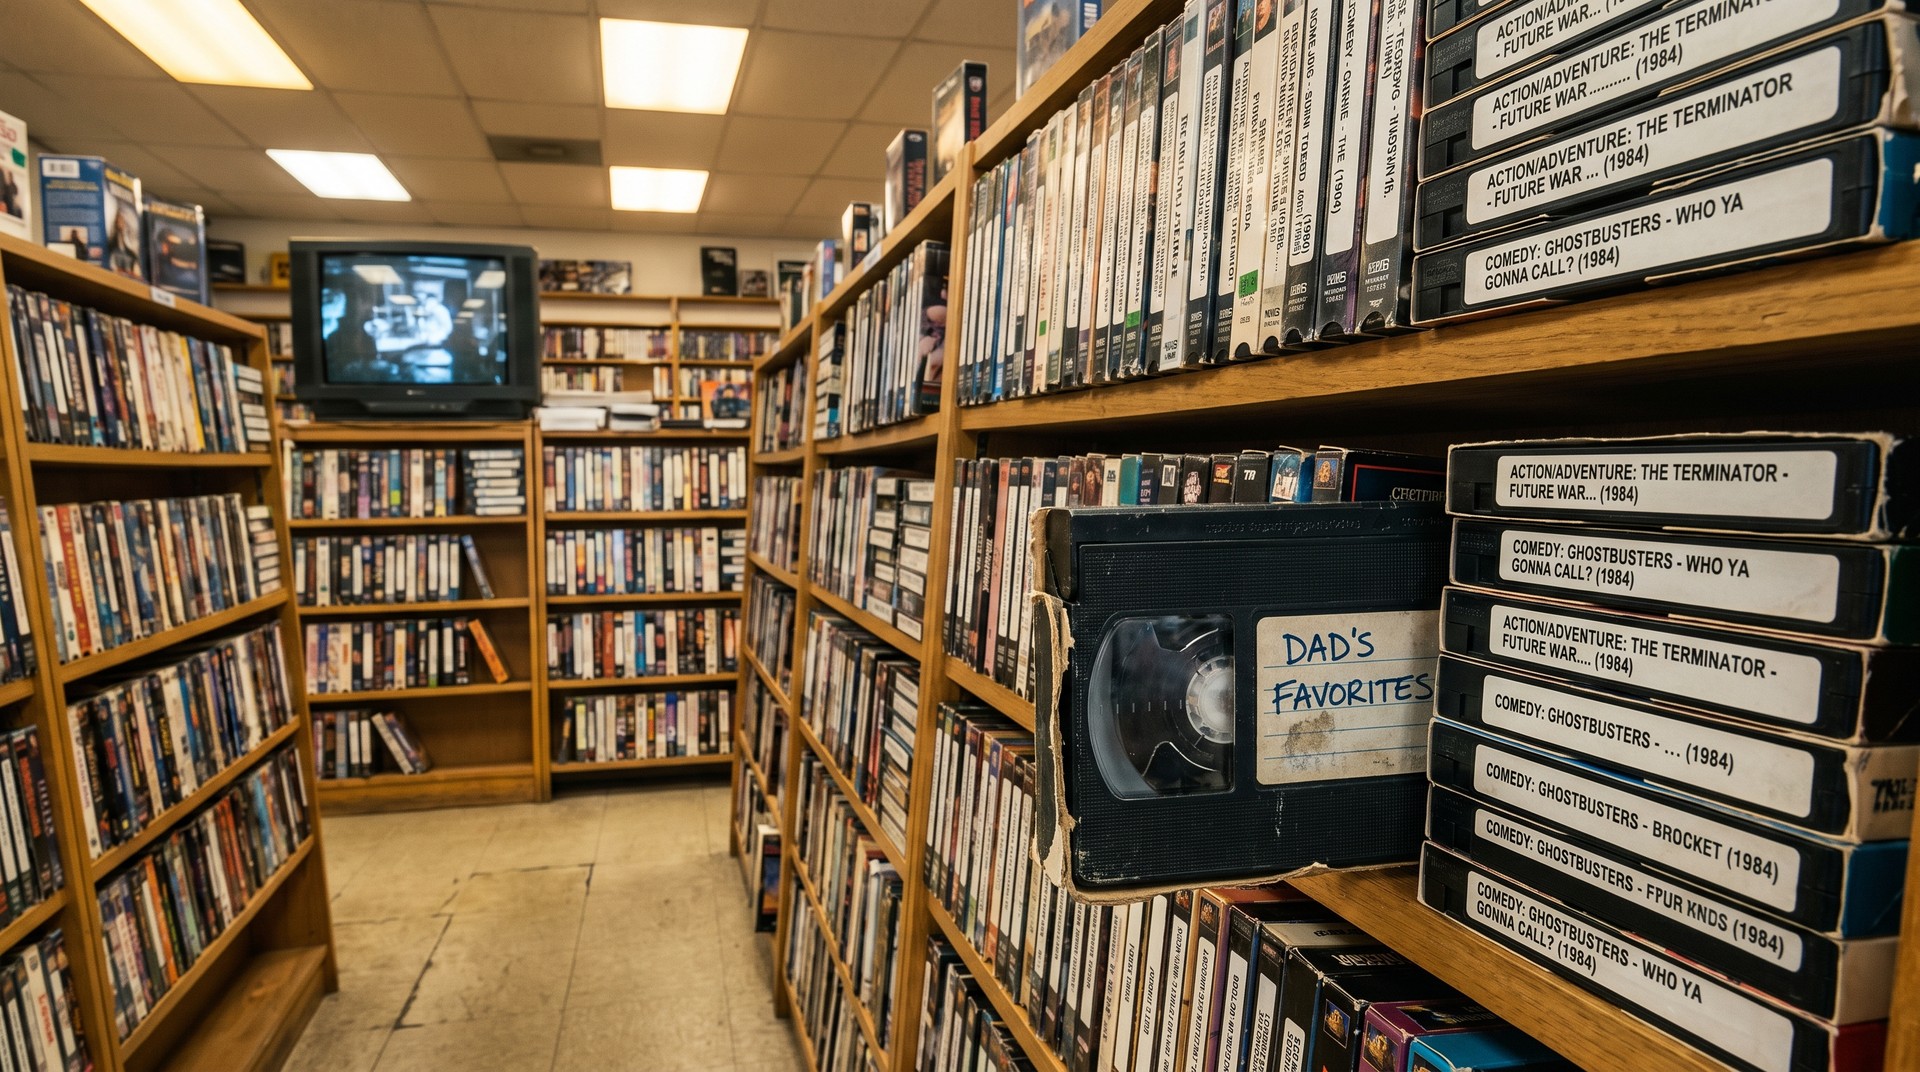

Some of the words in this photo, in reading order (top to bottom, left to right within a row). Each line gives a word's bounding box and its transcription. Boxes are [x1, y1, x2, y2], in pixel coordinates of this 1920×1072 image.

[1492, 41, 1635, 114] ACTION/ADVENTURE:
[1639, 23, 1671, 52] THE
[1503, 20, 1554, 58] FUTURE
[1500, 97, 1551, 130] FUTURE
[1636, 43, 1683, 80] (1984)
[1336, 134, 1347, 163] THE
[1487, 129, 1632, 190] ACTION/ADVENTURE:
[1637, 114, 1668, 140] THE
[1673, 72, 1793, 128] TERMINATOR
[1494, 177, 1545, 208] FUTURE
[1549, 165, 1582, 190] WAR
[1603, 144, 1649, 178] (1984)
[1485, 245, 1541, 271] COMEDY:
[1544, 213, 1661, 257] GHOSTBUSTERS
[1675, 199, 1716, 225] WHO
[1720, 192, 1744, 215] YA
[1485, 264, 1529, 290] GONNA
[1531, 256, 1574, 279] CALL?
[1578, 245, 1620, 275] (1984)
[1509, 484, 1554, 499] FUTURE
[1600, 485, 1639, 506] (1984)
[1510, 464, 1636, 480] ACTION/ADVENTURE:
[1641, 464, 1668, 480] THE
[1673, 463, 1777, 482] TERMINATOR
[1511, 558, 1551, 577] GONNA
[1554, 563, 1593, 582] CALL?
[1596, 566, 1635, 590] (1984)
[1513, 539, 1564, 559] COMEDY:
[1567, 544, 1673, 569] GHOSTBUSTERS
[1686, 555, 1723, 575] WHO
[1728, 559, 1750, 578] YA
[1283, 627, 1375, 665] DAD'S
[1502, 634, 1546, 656] FUTURE
[1595, 652, 1633, 678] (1984)
[1503, 615, 1627, 651] ACTION/ADVENTURE:
[1631, 637, 1658, 657] THE
[1662, 642, 1766, 678] TERMINATOR
[1272, 673, 1434, 715] FAVORITES
[1495, 694, 1545, 720] COMEDY:
[1548, 708, 1651, 749] GHOSTBUSTERS
[1686, 743, 1734, 775] (1984)
[1486, 762, 1535, 792] COMEDY:
[1538, 781, 1639, 830] GHOSTBUSTERS
[1652, 820, 1722, 860] BROCKET
[1727, 847, 1779, 886] (1984)
[1486, 819, 1534, 850] COMEDY:
[1537, 839, 1634, 892] GHOSTBUSTERS
[1733, 919, 1784, 960] (1984)
[1477, 900, 1515, 931] GONNA
[1518, 920, 1554, 951] CALL?
[1557, 940, 1597, 976] (1984)
[1477, 881, 1525, 917] COMEDY:
[1528, 906, 1629, 967] GHOSTBUSTERS
[1642, 958, 1678, 990] WHO
[1682, 978, 1703, 1003] YA
